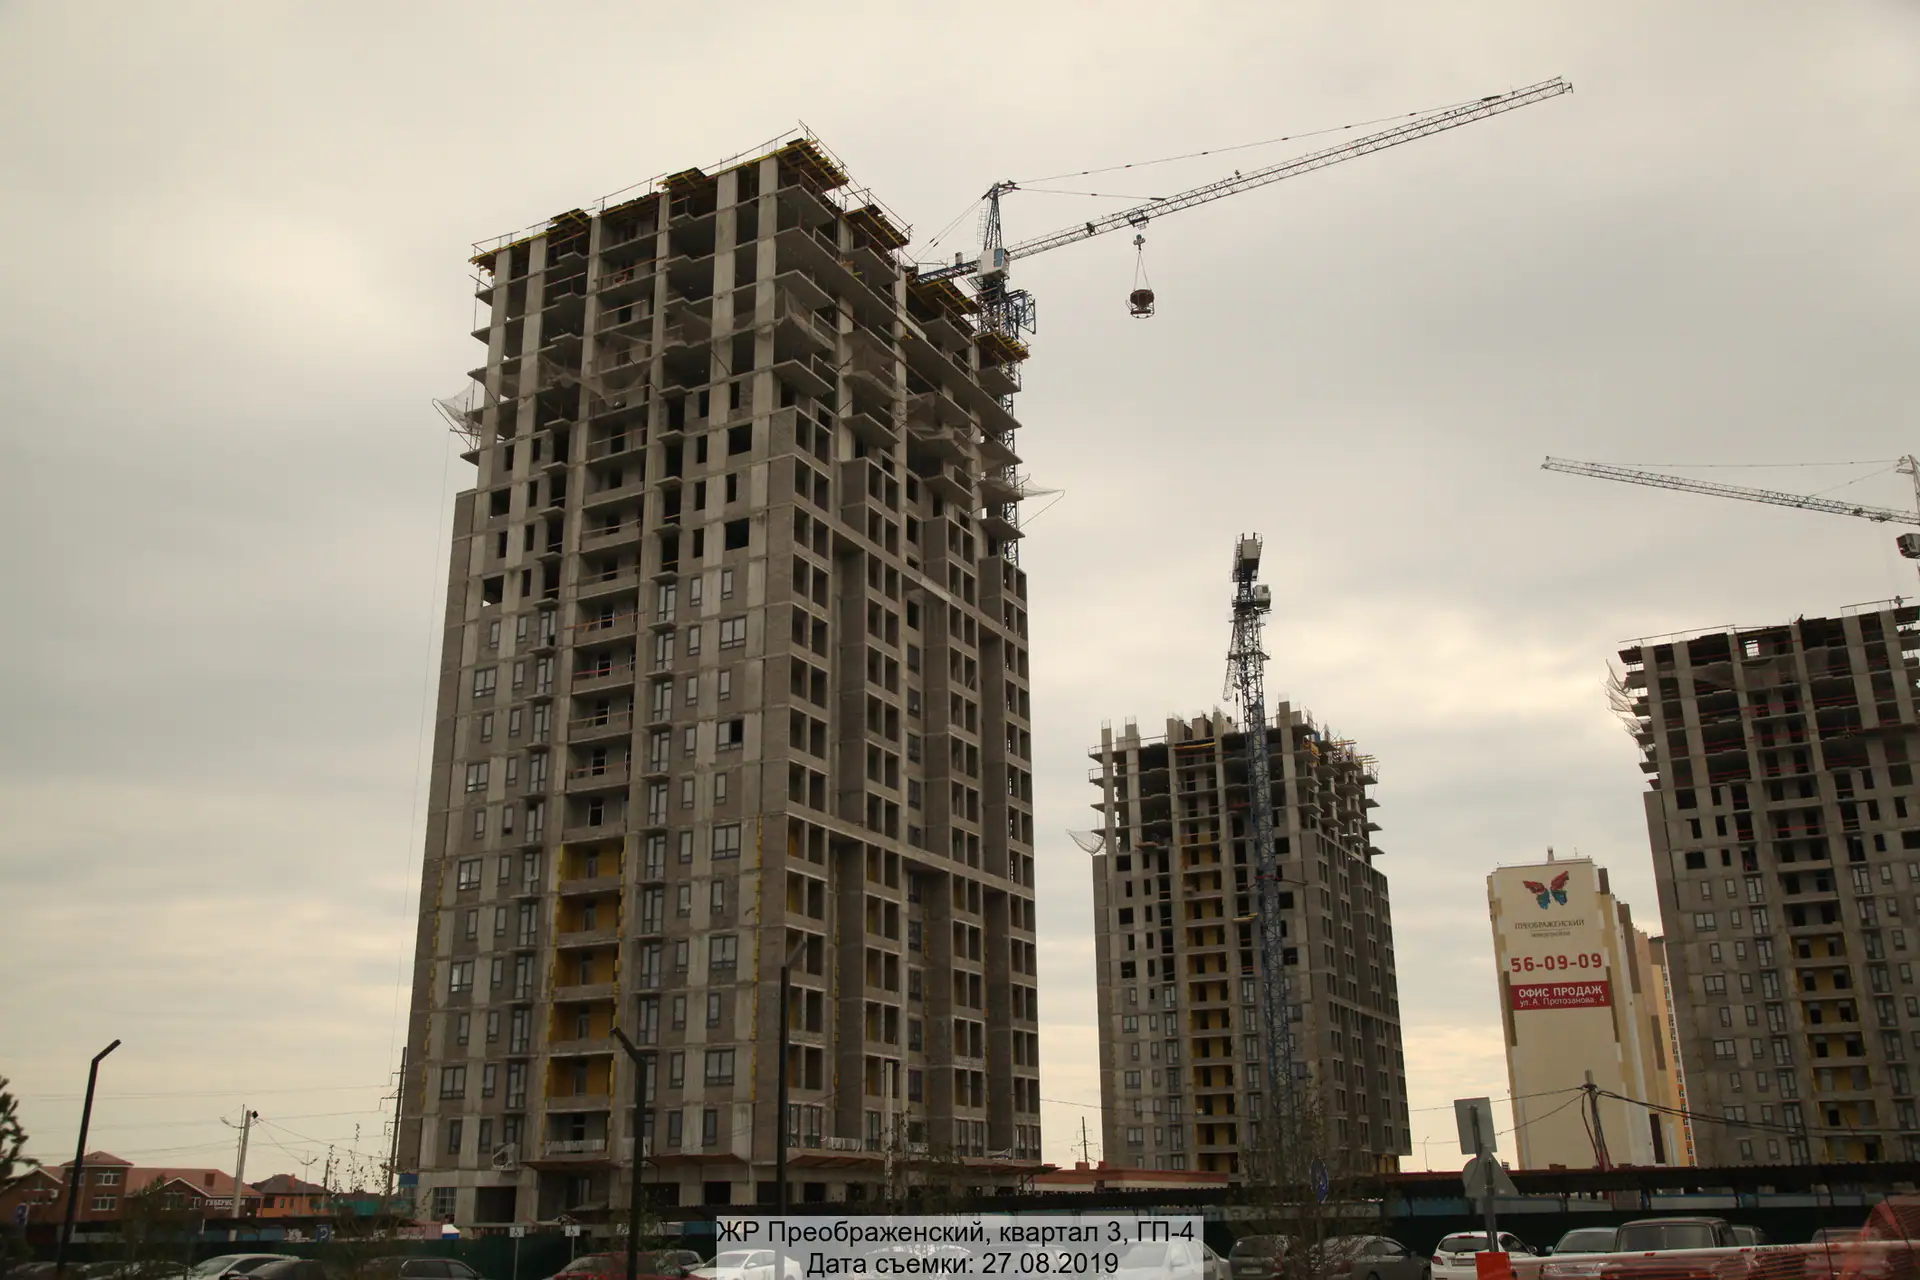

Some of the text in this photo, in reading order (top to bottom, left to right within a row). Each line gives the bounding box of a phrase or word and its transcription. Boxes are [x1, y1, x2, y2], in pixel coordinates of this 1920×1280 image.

[1515, 919, 1584, 929] ПРЕОБРАЖЕНСКИЙ
[1511, 953, 1602, 972] 56-09-09
[1518, 985, 1602, 998] ОФИС ПРОДАЖ
